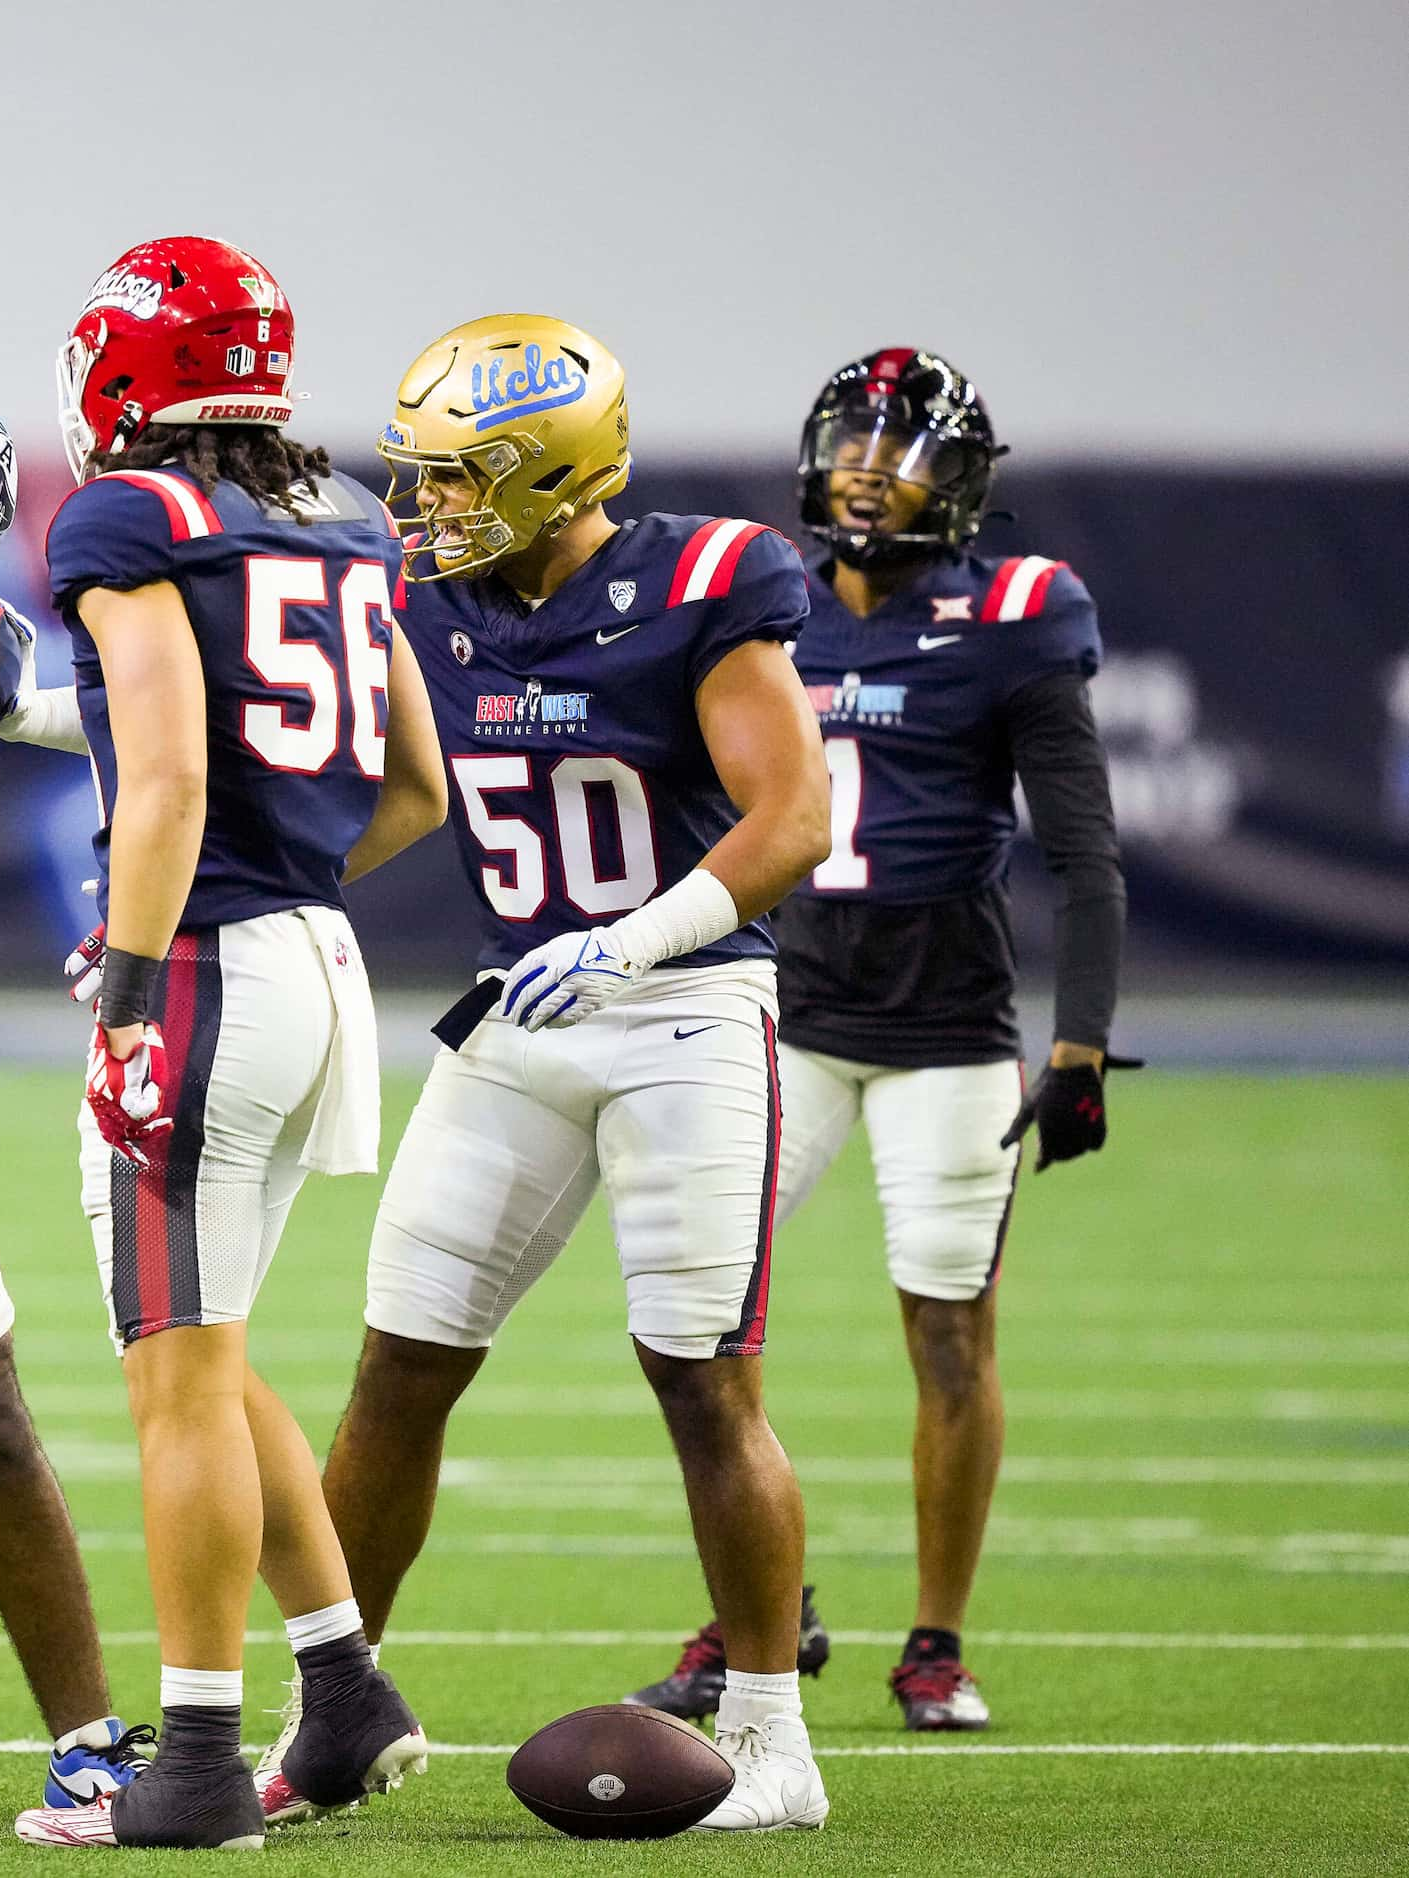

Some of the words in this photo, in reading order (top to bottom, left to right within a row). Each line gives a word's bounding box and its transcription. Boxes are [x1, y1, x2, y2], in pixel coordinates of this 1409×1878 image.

[257, 320, 270, 342] 6
[198, 405, 263, 419] FRESNO
[240, 554, 393, 780] 56
[476, 694, 518, 722] EAST
[541, 693, 589, 721] WEST
[474, 725, 533, 735] SHRINE
[543, 723, 588, 734] BOWL
[448, 753, 662, 922] 50
